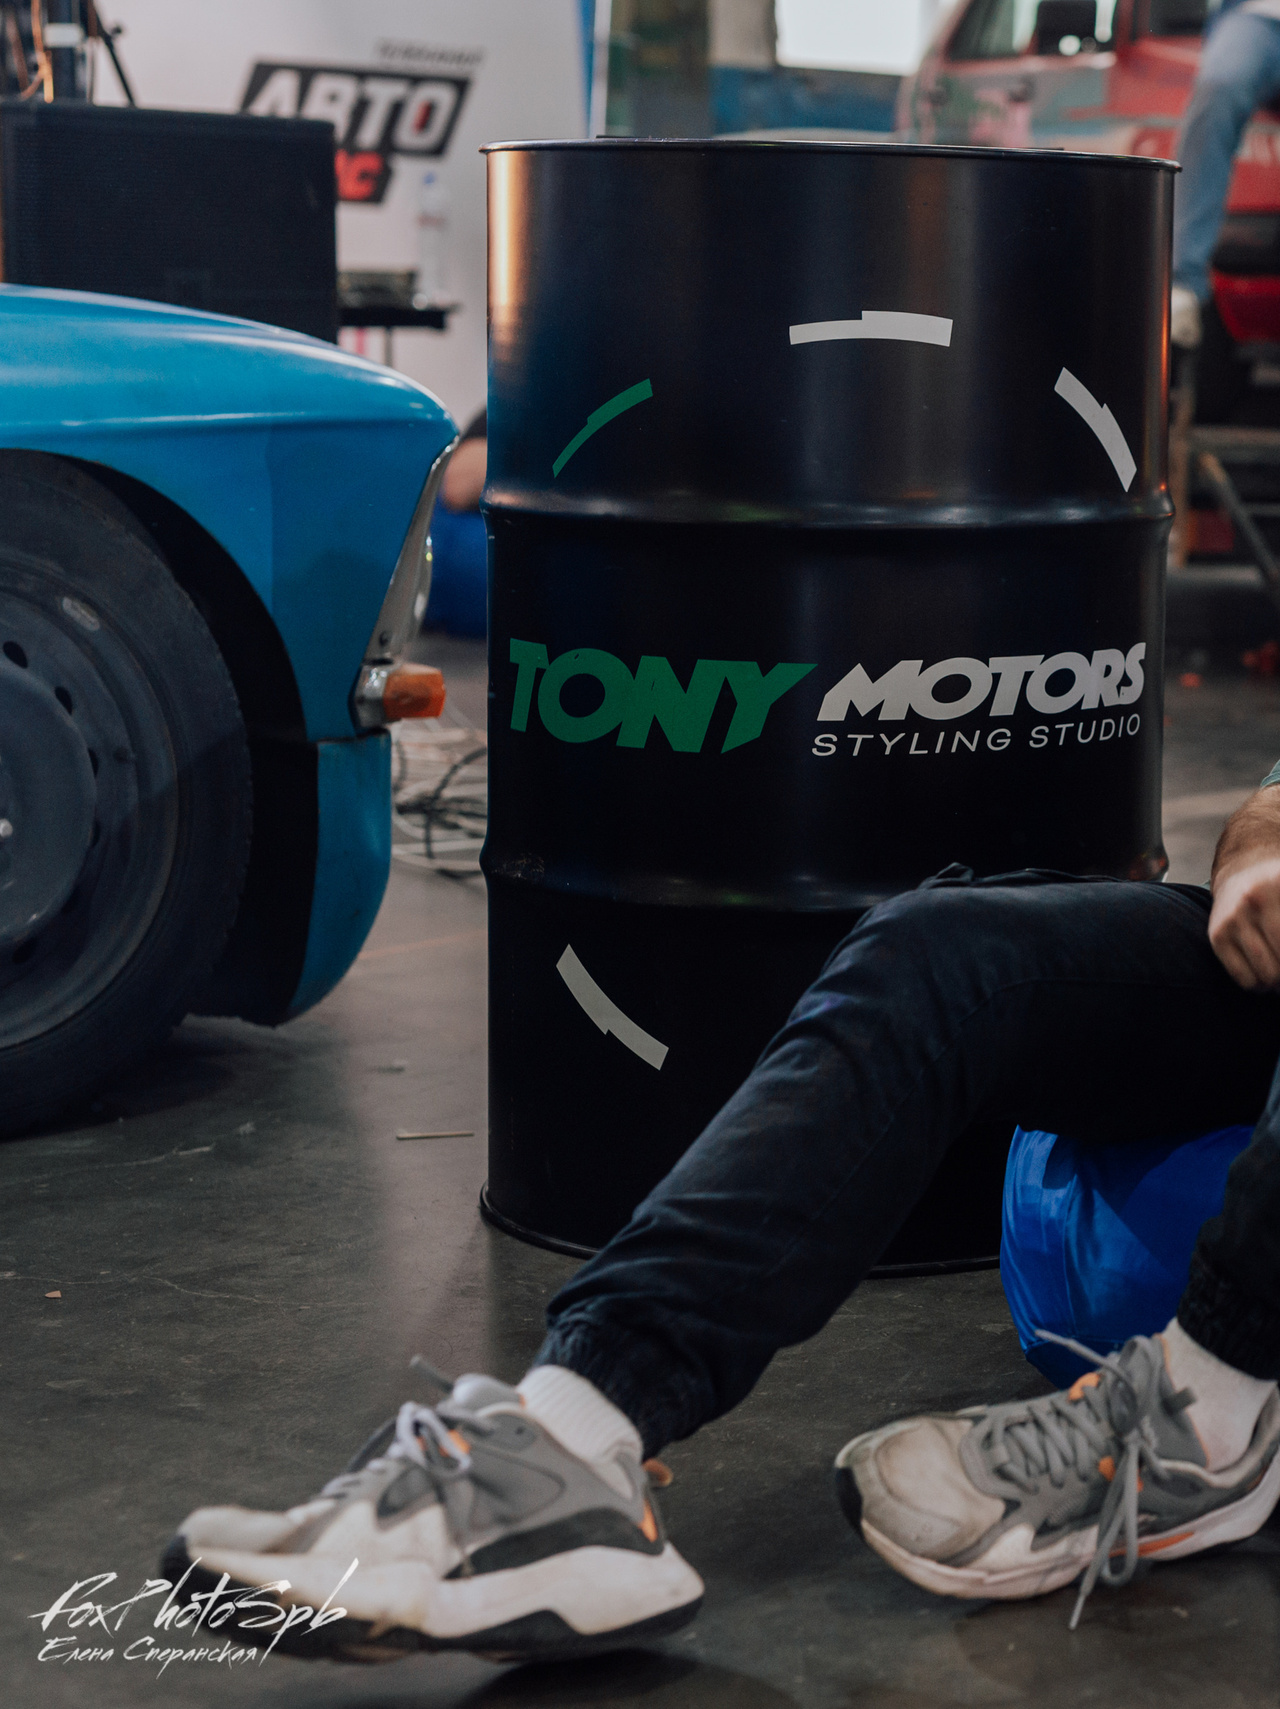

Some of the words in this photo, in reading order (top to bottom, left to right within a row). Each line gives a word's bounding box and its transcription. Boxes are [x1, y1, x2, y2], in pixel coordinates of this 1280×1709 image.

[509, 637, 818, 755] TONY
[816, 641, 1147, 722] MOTORS
[811, 730, 1013, 757] STYLING
[1028, 713, 1142, 749] STUDIO
